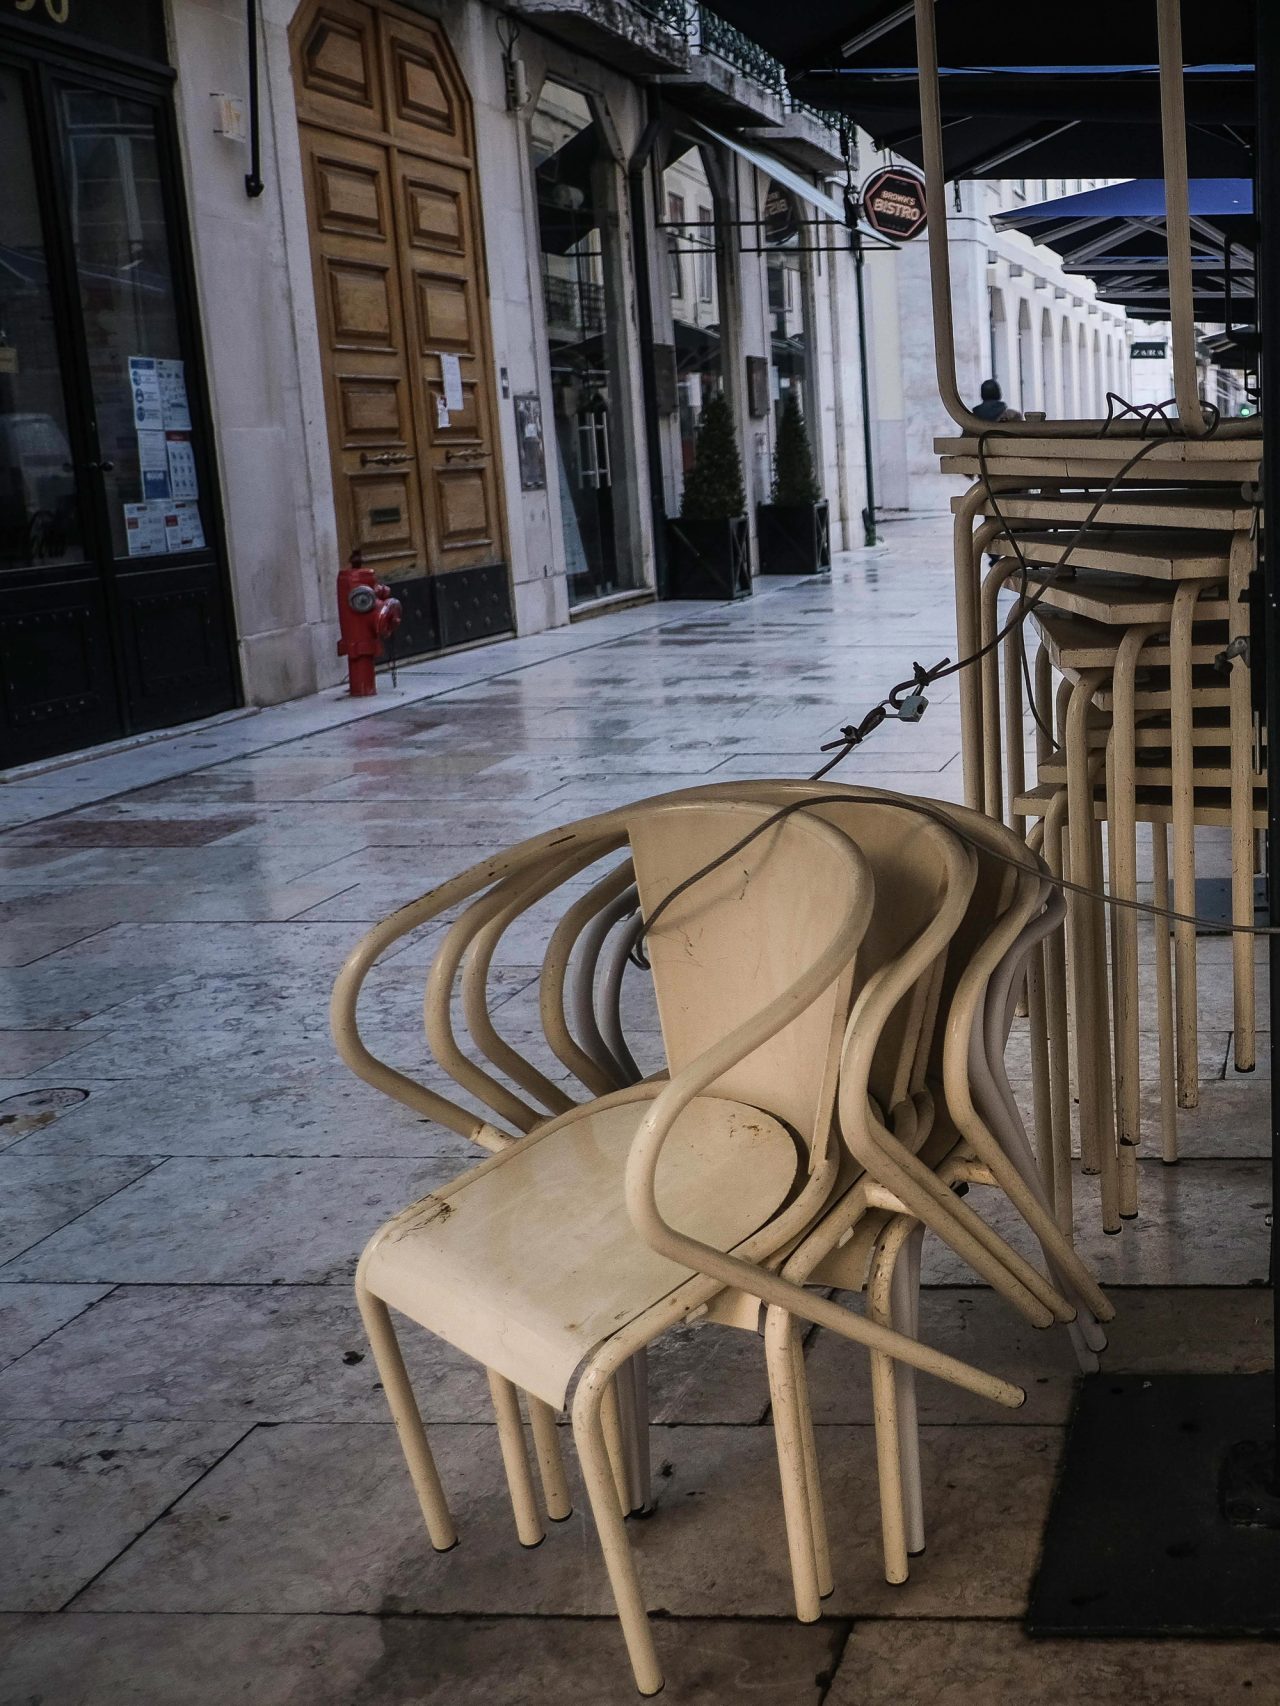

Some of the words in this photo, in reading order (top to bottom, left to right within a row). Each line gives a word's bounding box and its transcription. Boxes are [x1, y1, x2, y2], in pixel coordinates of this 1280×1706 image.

[881, 190, 916, 206] BROWN'S
[873, 198, 921, 221] BISTRO
[1132, 349, 1164, 357] ZARA
